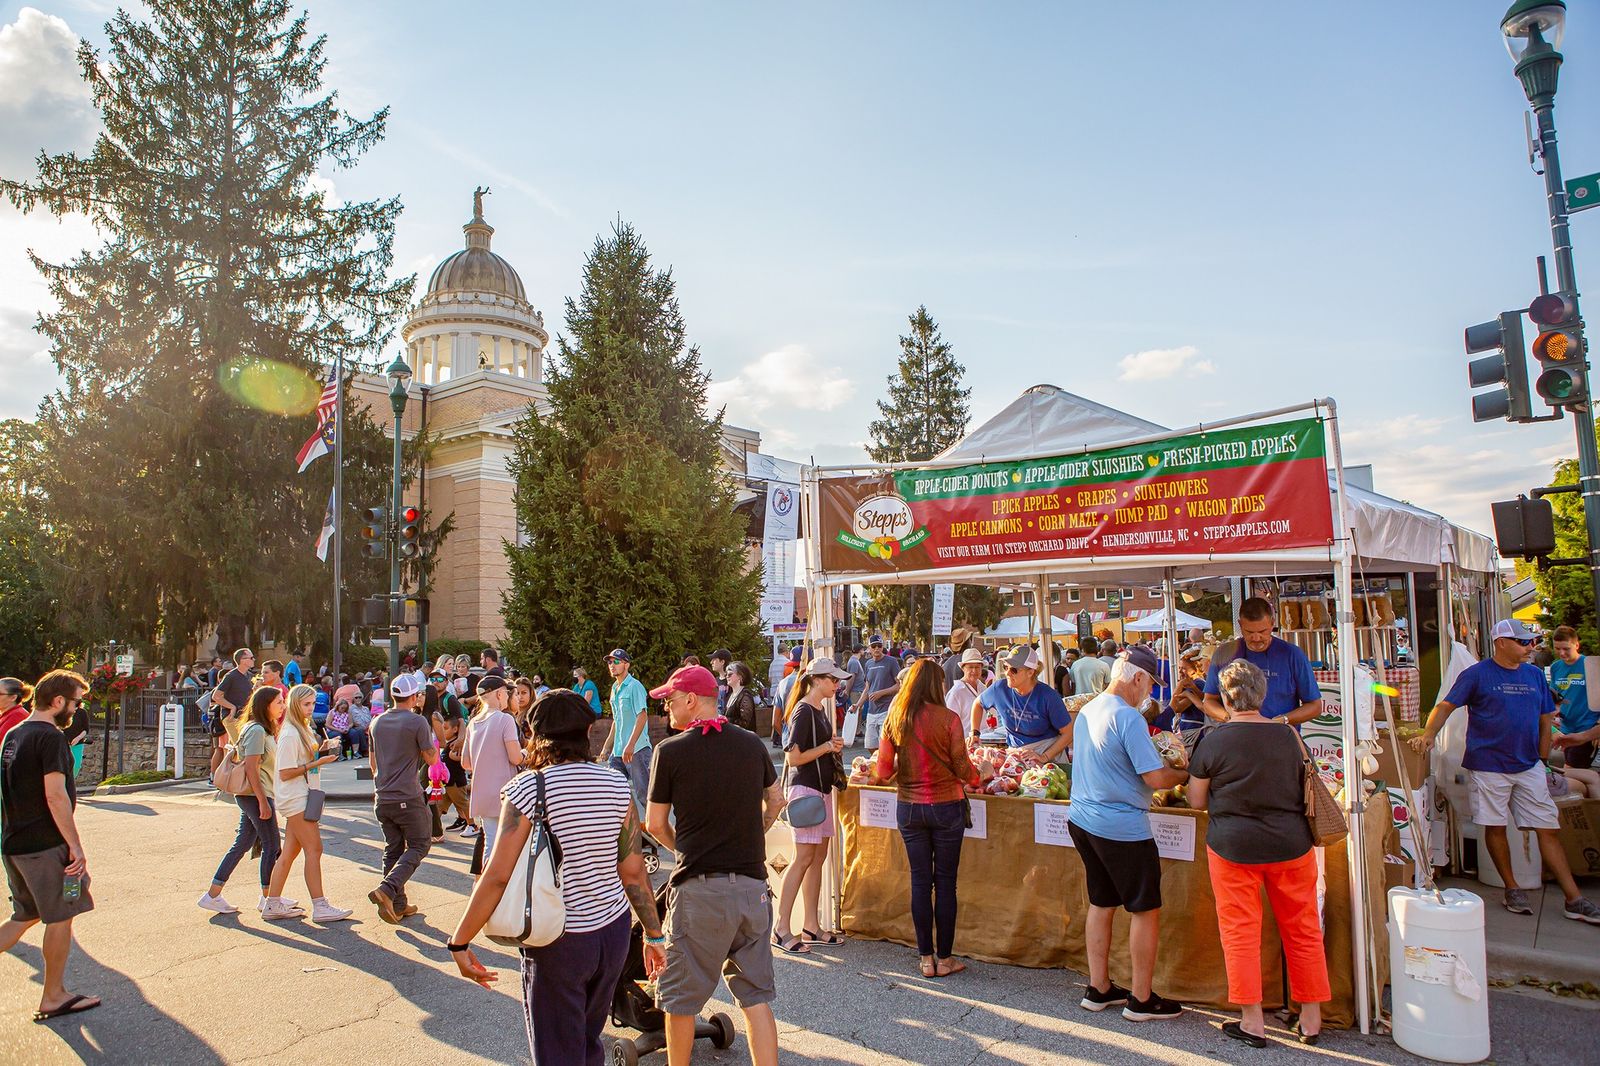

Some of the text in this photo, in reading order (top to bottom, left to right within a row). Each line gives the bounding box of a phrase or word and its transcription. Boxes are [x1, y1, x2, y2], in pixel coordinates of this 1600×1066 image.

[1163, 434, 1297, 468] FRESH-PICKED APPLES
[1024, 454, 1145, 484] APPLE-CIDER SLUSHIES
[914, 471, 1009, 496] APPLE-CIDER DONUTS
[1134, 478, 1209, 501] SUNFLOWERS
[992, 494, 1060, 516] U-PICK APPLES
[1077, 488, 1117, 507] GRAPES
[1186, 494, 1266, 518] WAGON RIDES
[858, 507, 908, 534] Stepp's
[1038, 511, 1098, 531] CORN MAZE
[1114, 503, 1168, 525] JUMP PAD
[902, 530, 925, 547] ORCHARD
[950, 517, 1023, 538] APPLE CANNONS
[1102, 528, 1190, 547] HENDERSONVILLE, NC
[1203, 519, 1291, 540] STEPPSAPPLES.COM
[840, 534, 866, 549] HILLCREST
[937, 537, 1089, 559] VISIT OUR FARM 170 STEPP ORCHARD DRIVE
